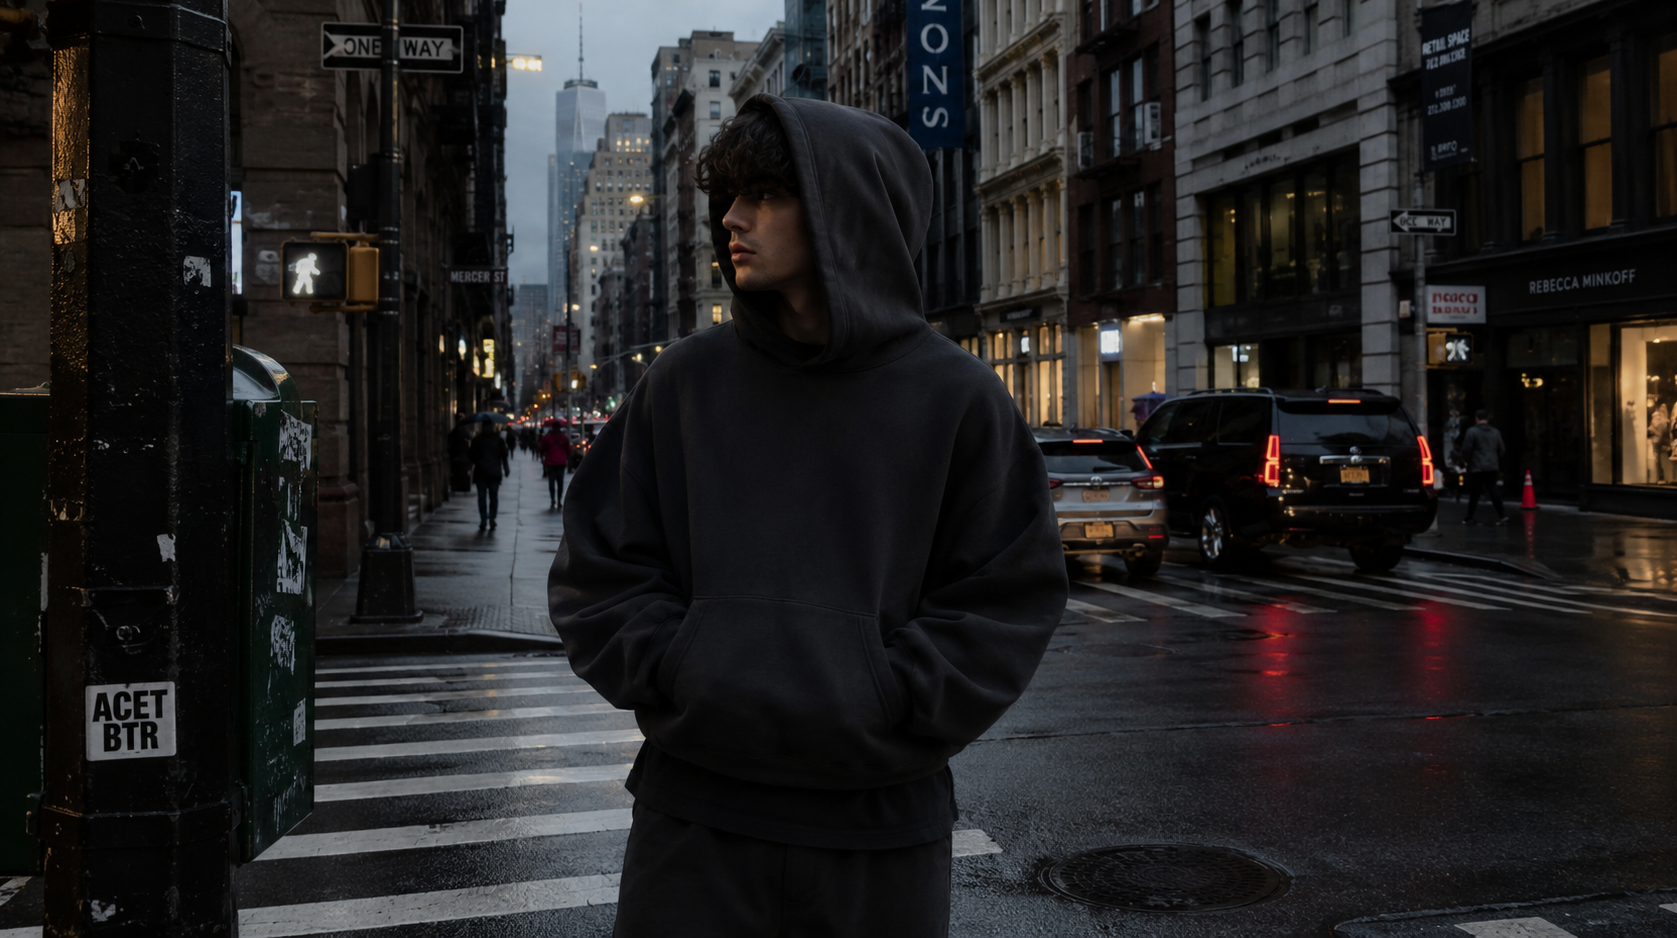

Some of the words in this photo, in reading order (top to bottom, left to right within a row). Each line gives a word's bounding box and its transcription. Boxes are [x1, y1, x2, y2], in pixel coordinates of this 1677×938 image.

[344, 37, 382, 55] ONE
[403, 39, 444, 57] WAY
[1427, 217, 1447, 227] WAY
[450, 270, 491, 284] MERCER
[494, 271, 506, 283] ST
[1528, 275, 1580, 295] REBECCA
[1582, 268, 1636, 288] MINKOFF
[92, 689, 168, 722] ACET
[103, 721, 158, 752] BTR
